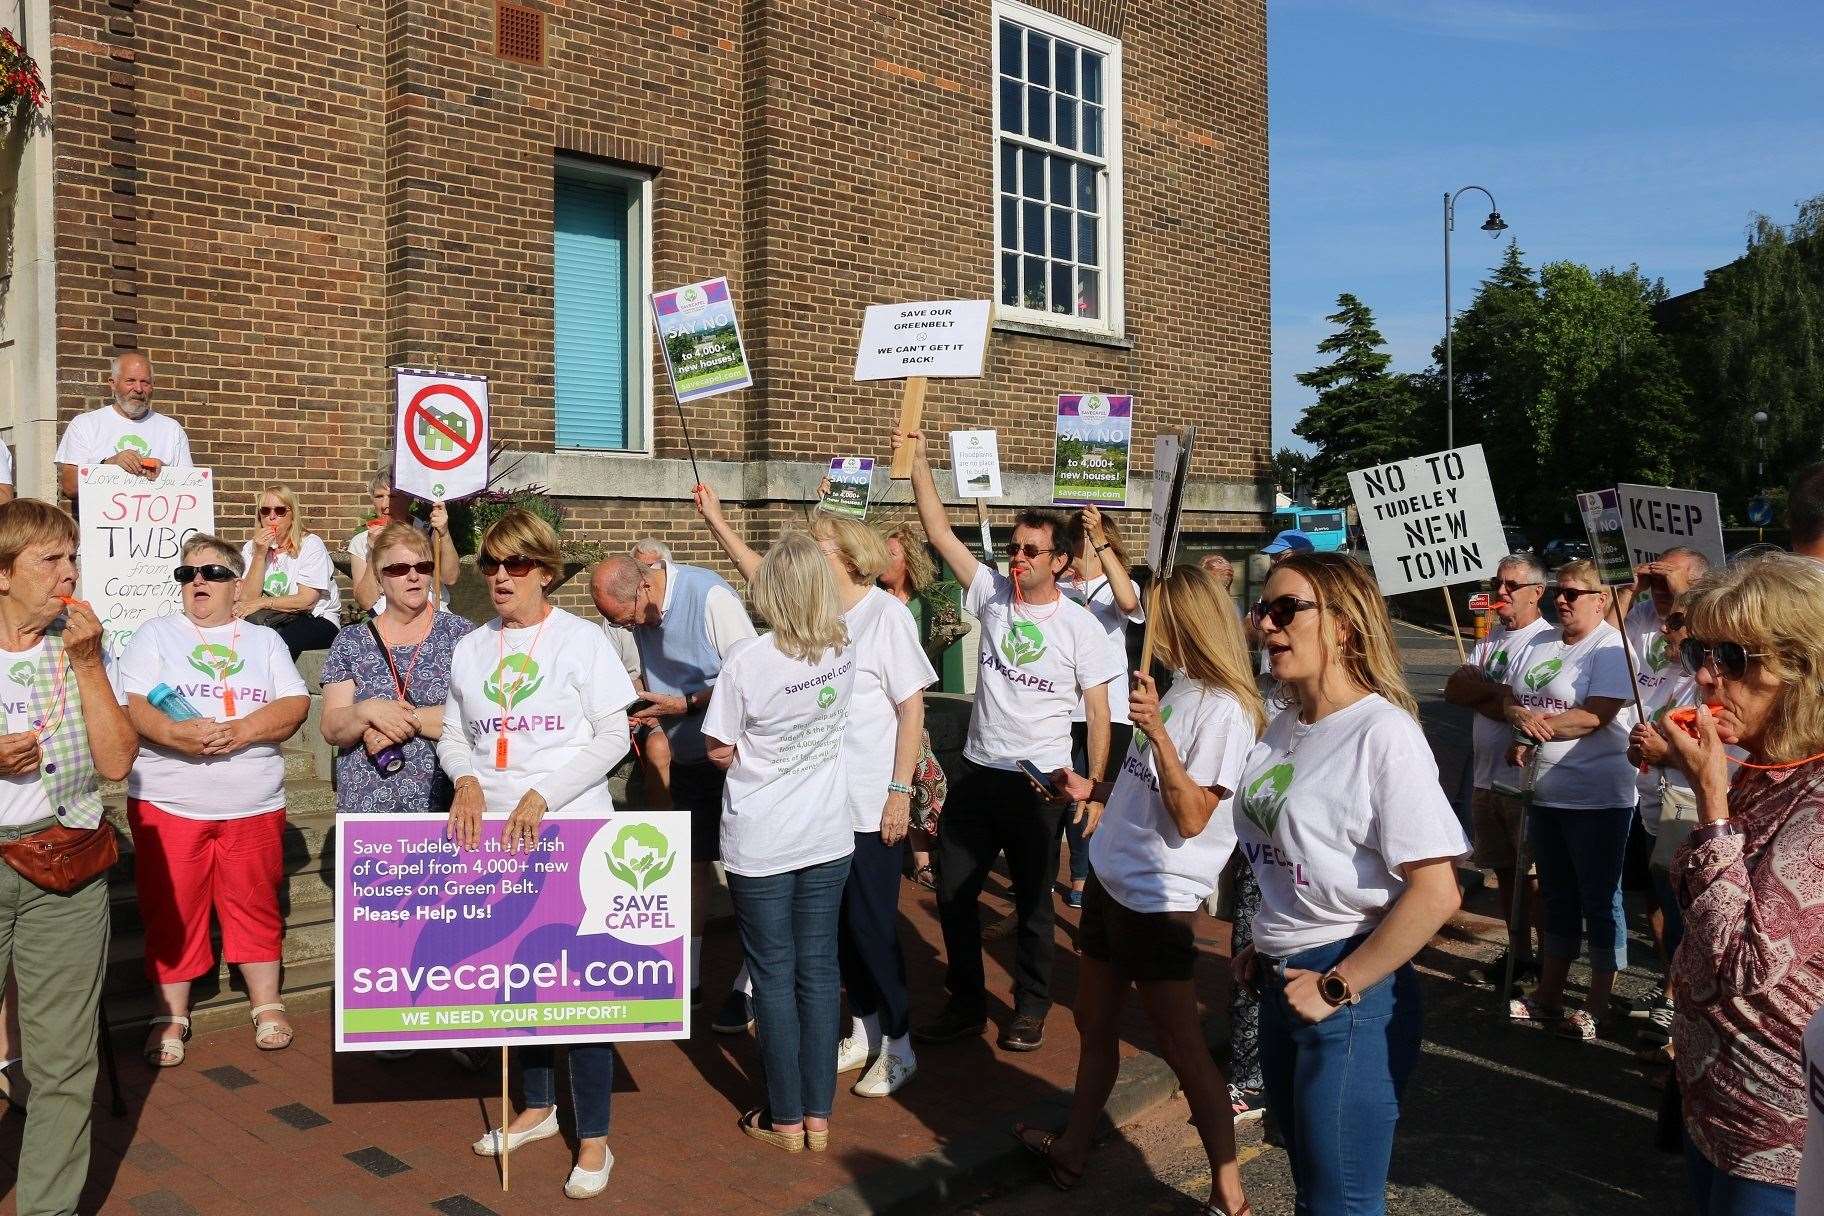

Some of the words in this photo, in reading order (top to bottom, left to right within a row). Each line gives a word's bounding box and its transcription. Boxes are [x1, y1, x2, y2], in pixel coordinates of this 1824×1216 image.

[900, 310, 927, 318] SAVE
[668, 319, 697, 339] SAY
[705, 313, 728, 331] NO
[893, 321, 955, 331] GREENBELT
[682, 353, 692, 361] to
[694, 344, 727, 358] 4,000+
[895, 345, 926, 353] CAN'T
[678, 363, 699, 373] new
[700, 353, 736, 368] houses!
[680, 371, 742, 390] savecapel.com
[1062, 428, 1093, 442] SAY
[1098, 429, 1124, 442] NO
[1067, 459, 1078, 467] to
[1080, 459, 1114, 468] 4,000+
[85, 466, 120, 485] Love
[851, 476, 867, 485] NO
[1083, 471, 1119, 480] houses!
[1363, 465, 1406, 498] NO
[1425, 452, 1465, 485] TO
[1059, 489, 1120, 498] savecapel.com
[102, 492, 197, 524] STOP
[1373, 487, 1458, 521] TUDELEY
[1600, 519, 1618, 532] NO
[1629, 498, 1703, 536] KEEP
[1403, 510, 1468, 548] NEW
[128, 562, 168, 577] from
[1397, 543, 1483, 582] TOWN
[110, 602, 146, 619] Over
[157, 599, 183, 618] Ou
[785, 661, 852, 695] savecapel.com
[175, 684, 268, 704] AVECPEL
[353, 839, 392, 855] Save
[397, 838, 460, 857] Tudeley
[353, 861, 370, 876] of
[375, 859, 424, 879] Capel
[428, 858, 467, 874] from
[473, 859, 529, 875] 4,000+
[534, 861, 569, 873] new
[353, 882, 412, 896] houses
[417, 885, 438, 896] on
[444, 881, 496, 895] Green
[501, 879, 538, 894] Belt.
[612, 894, 668, 912] SAVE
[353, 906, 410, 922] Please
[416, 905, 457, 923] Help
[463, 904, 492, 919] Us!
[605, 912, 676, 930] CAPEL
[352, 949, 674, 1002] savecapel.com
[401, 1011, 430, 1027] WE
[435, 1010, 484, 1025] NEED
[489, 1008, 537, 1023] YOUR
[543, 1005, 627, 1021] SUPPORT!
